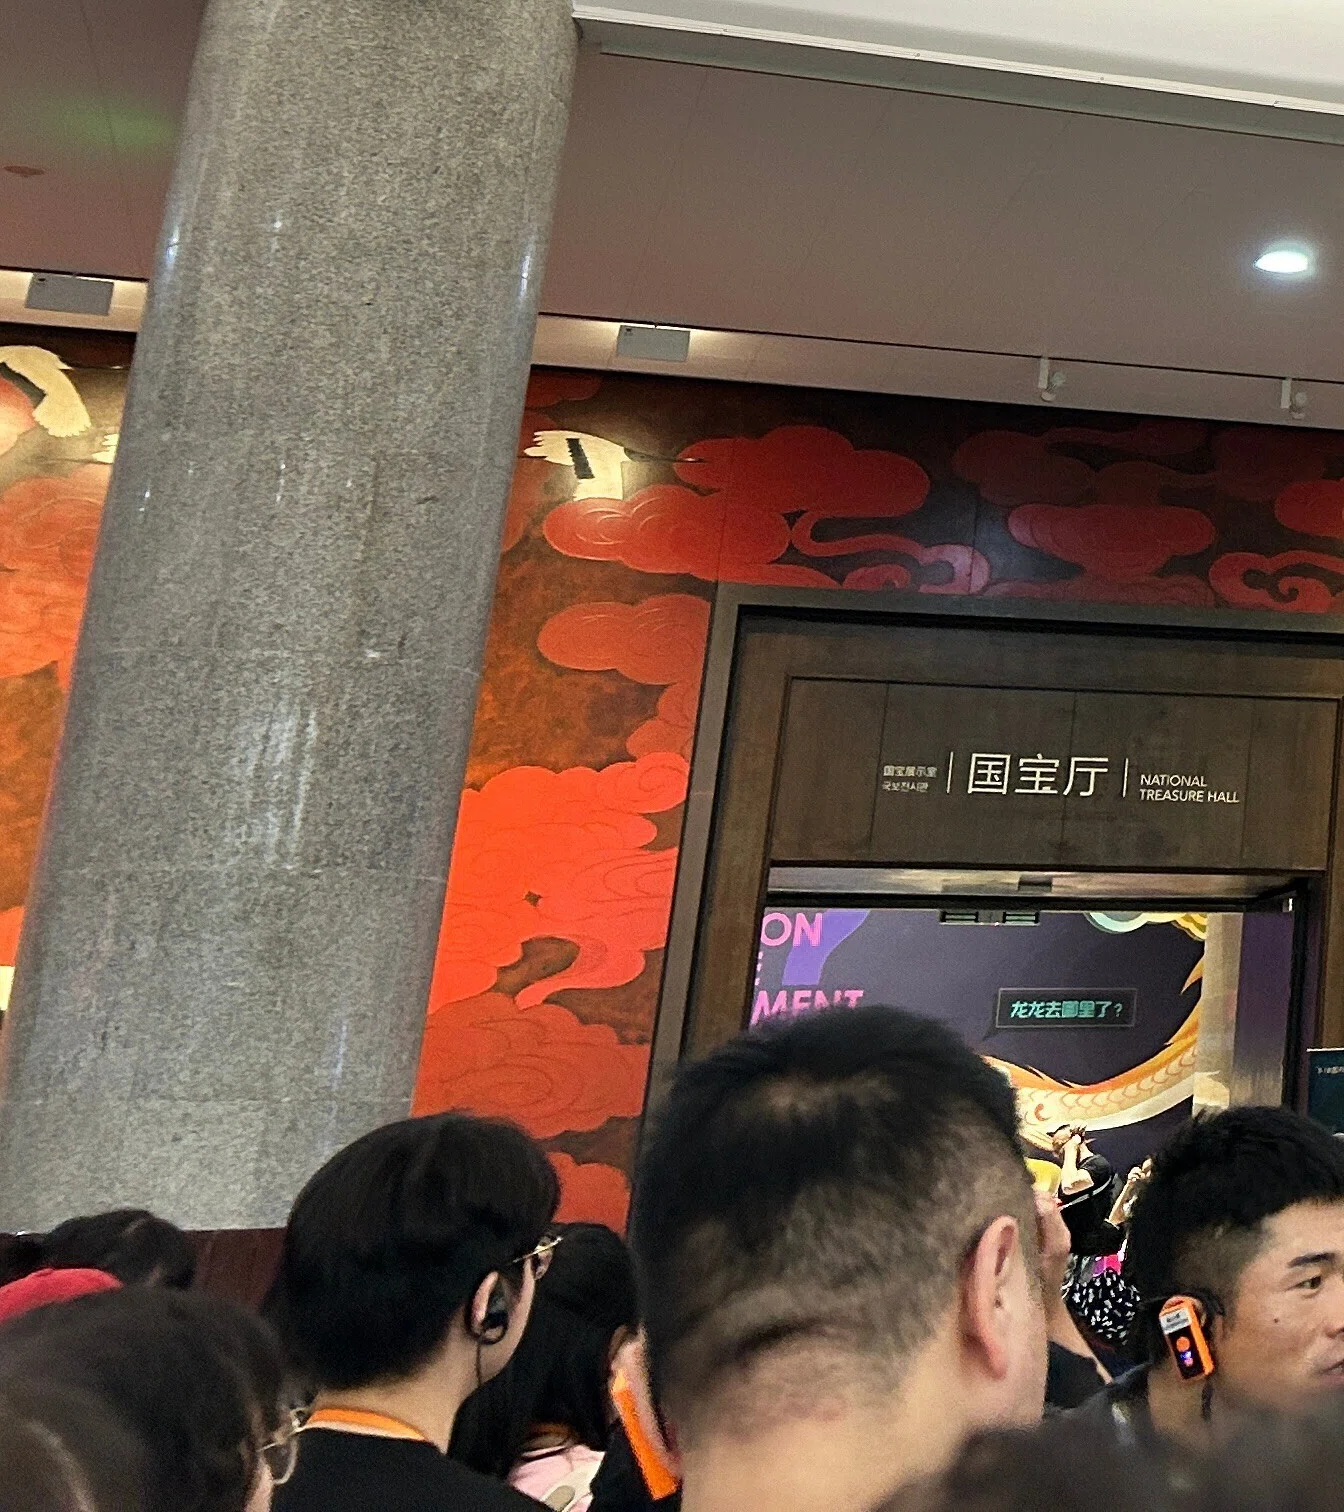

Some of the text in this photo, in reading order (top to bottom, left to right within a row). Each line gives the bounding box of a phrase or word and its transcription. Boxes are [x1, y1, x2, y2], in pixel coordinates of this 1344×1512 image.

[967, 753, 1109, 797] 国宝厅
[1139, 773, 1208, 788] NATIONAL
[1139, 788, 1240, 803] TREASURE HALL
